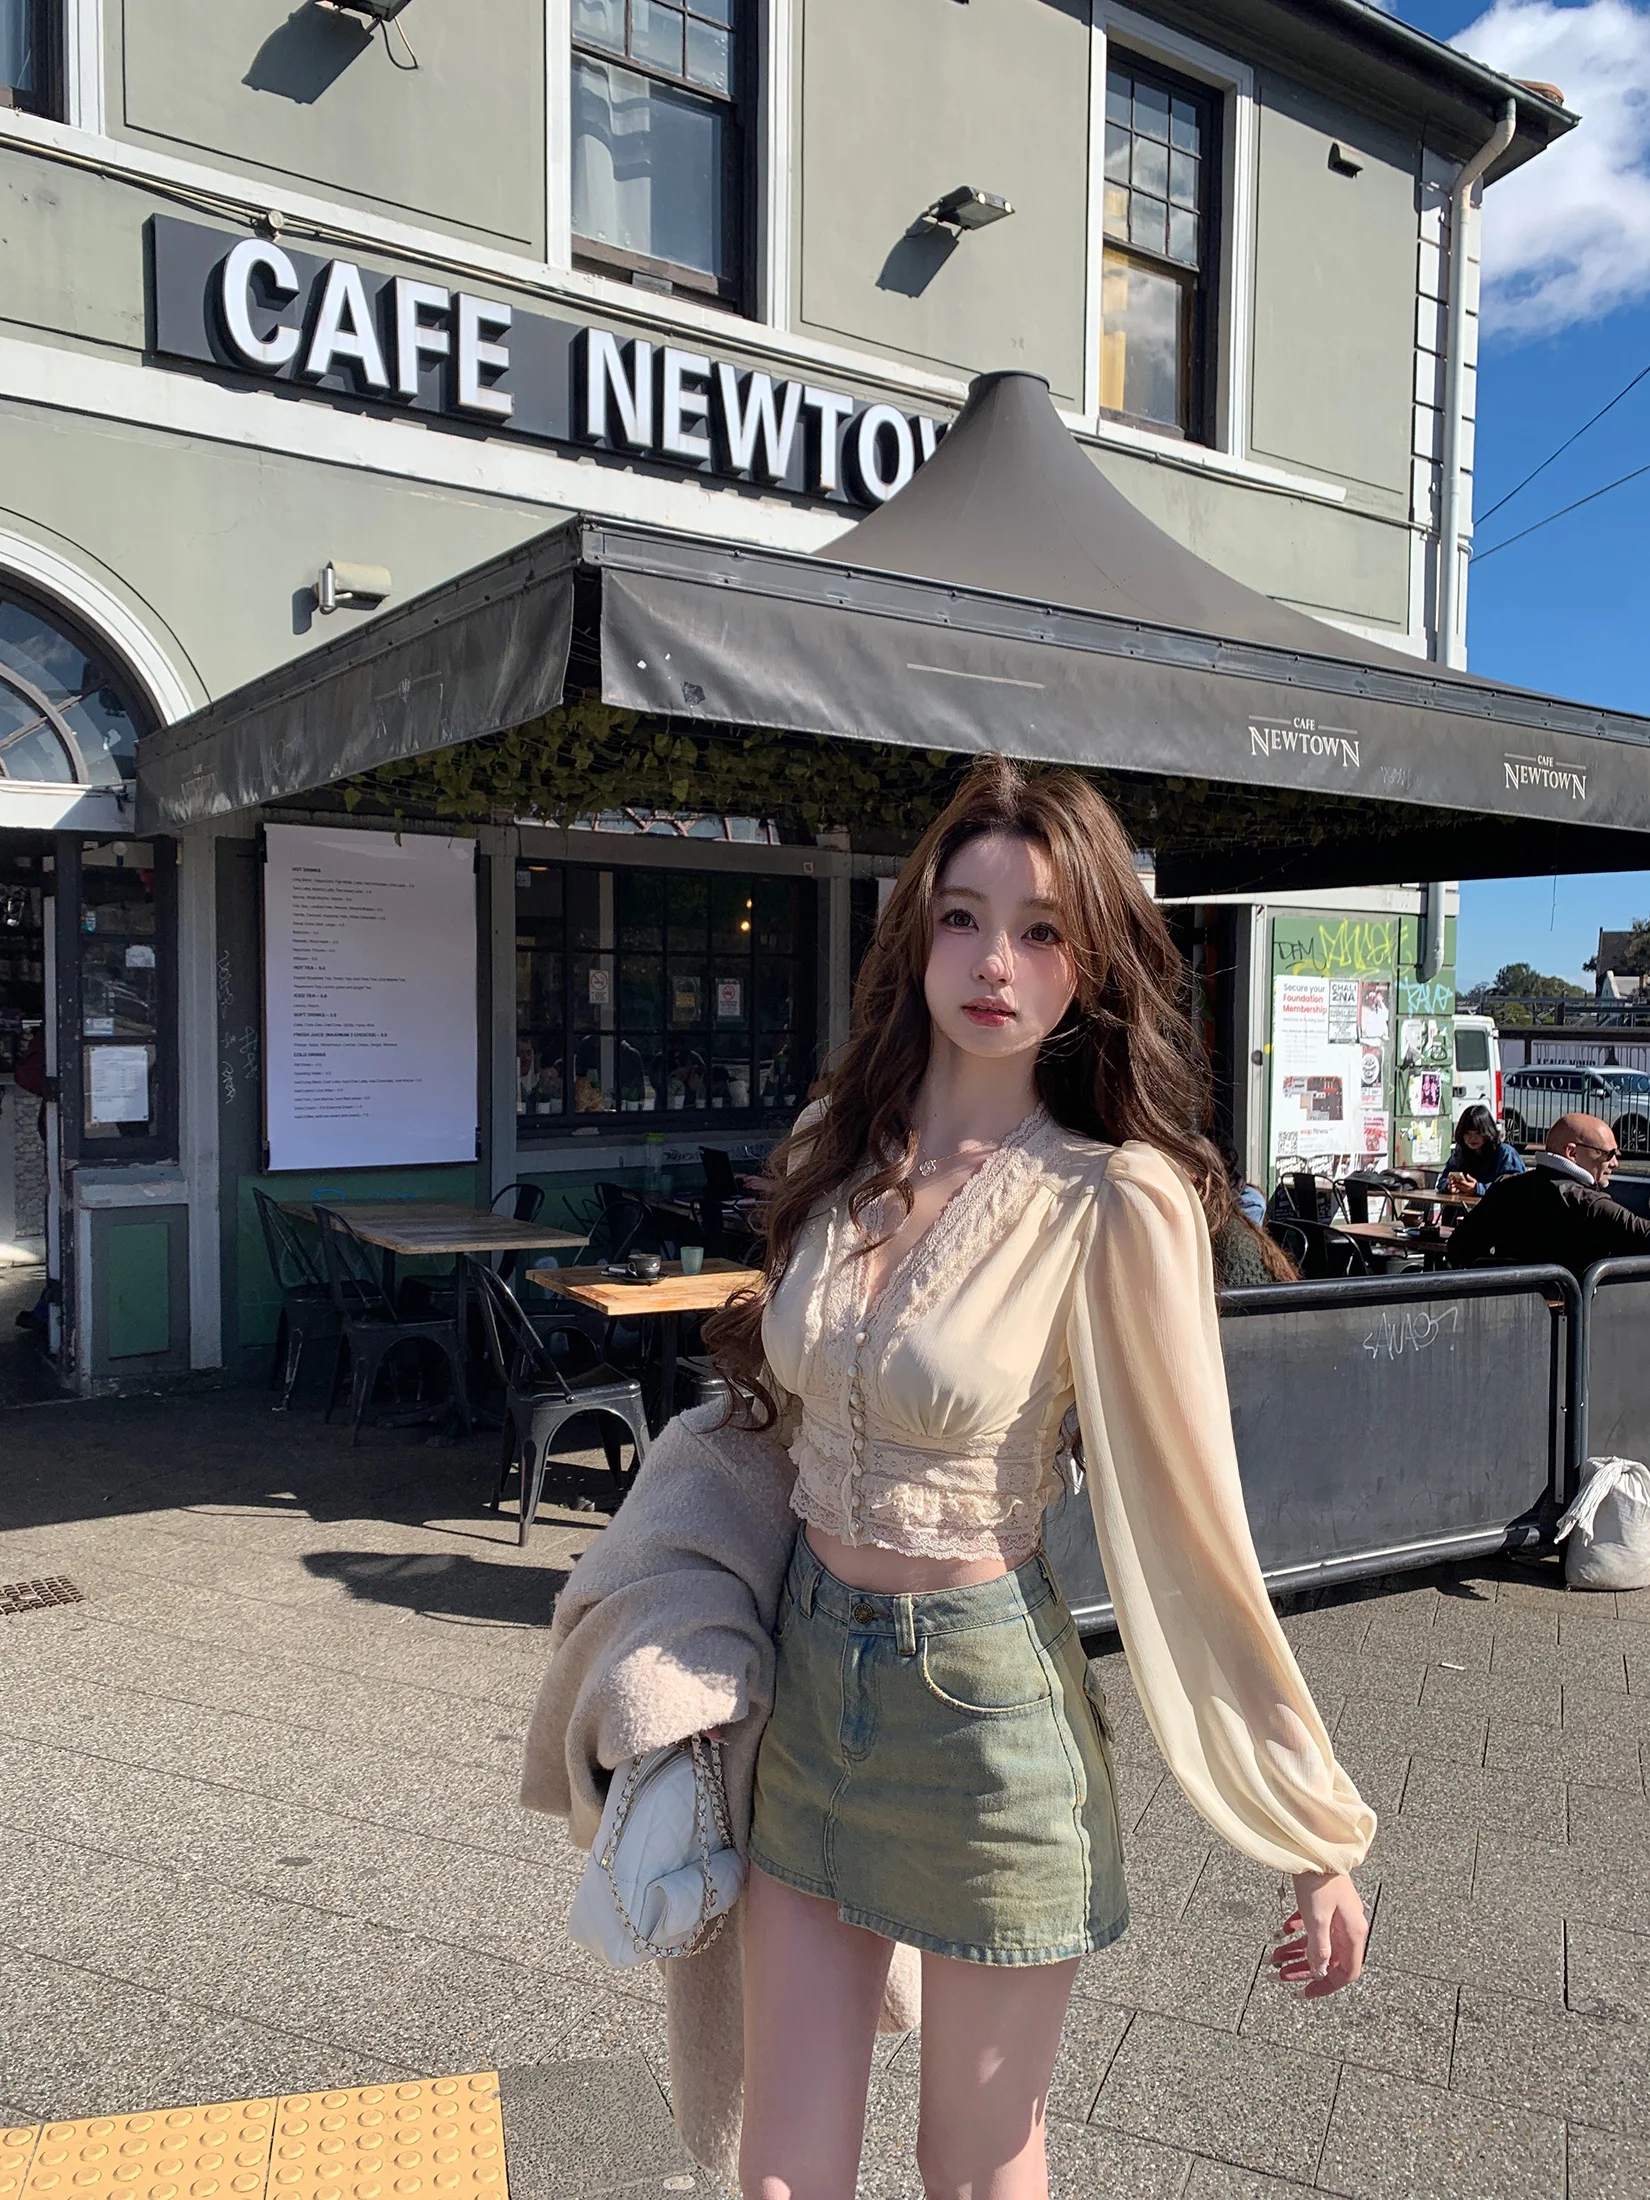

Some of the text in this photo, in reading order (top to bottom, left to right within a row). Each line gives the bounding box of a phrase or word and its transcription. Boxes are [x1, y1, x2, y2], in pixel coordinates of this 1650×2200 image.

[220, 237, 515, 420] CAFE
[1293, 717, 1316, 731] CAFE
[1248, 725, 1361, 768] NEWTOWN
[1537, 754, 1554, 767] CAFE
[1503, 762, 1587, 800] NEWTOWN
[1283, 983, 1326, 995] Secure your
[1332, 984, 1357, 992] CHALI
[1283, 994, 1323, 1004] Foundation
[1332, 992, 1356, 1002] 2NA
[1283, 1005, 1328, 1015] Membership
